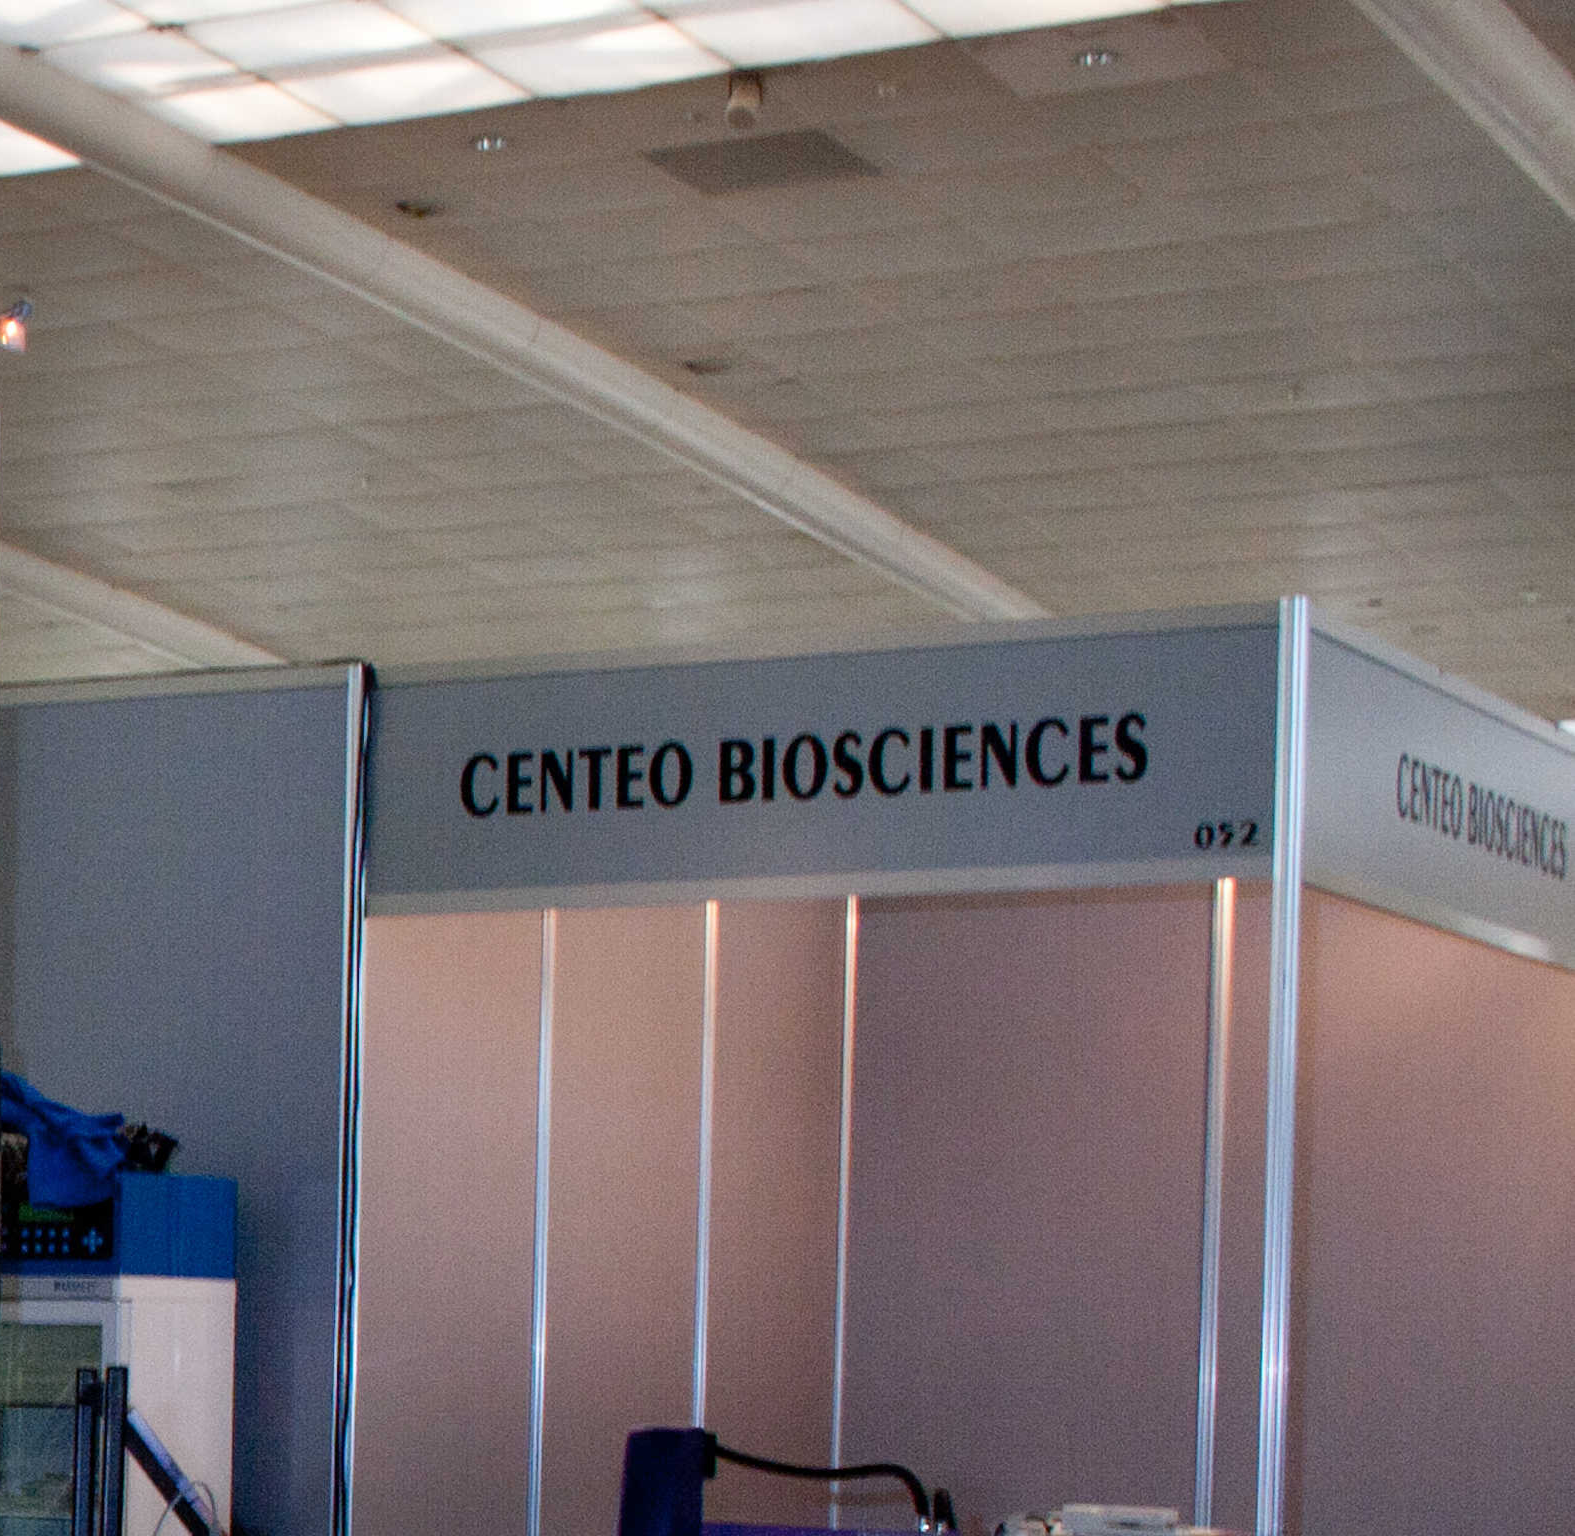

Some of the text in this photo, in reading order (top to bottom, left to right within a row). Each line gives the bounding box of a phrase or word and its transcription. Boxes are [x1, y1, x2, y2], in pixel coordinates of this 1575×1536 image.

[460, 713, 1150, 817] CENTEO BIOSCIENCES
[1396, 753, 1567, 879] CENTEO BIOSCIENCES
[1194, 821, 1259, 849] 052
